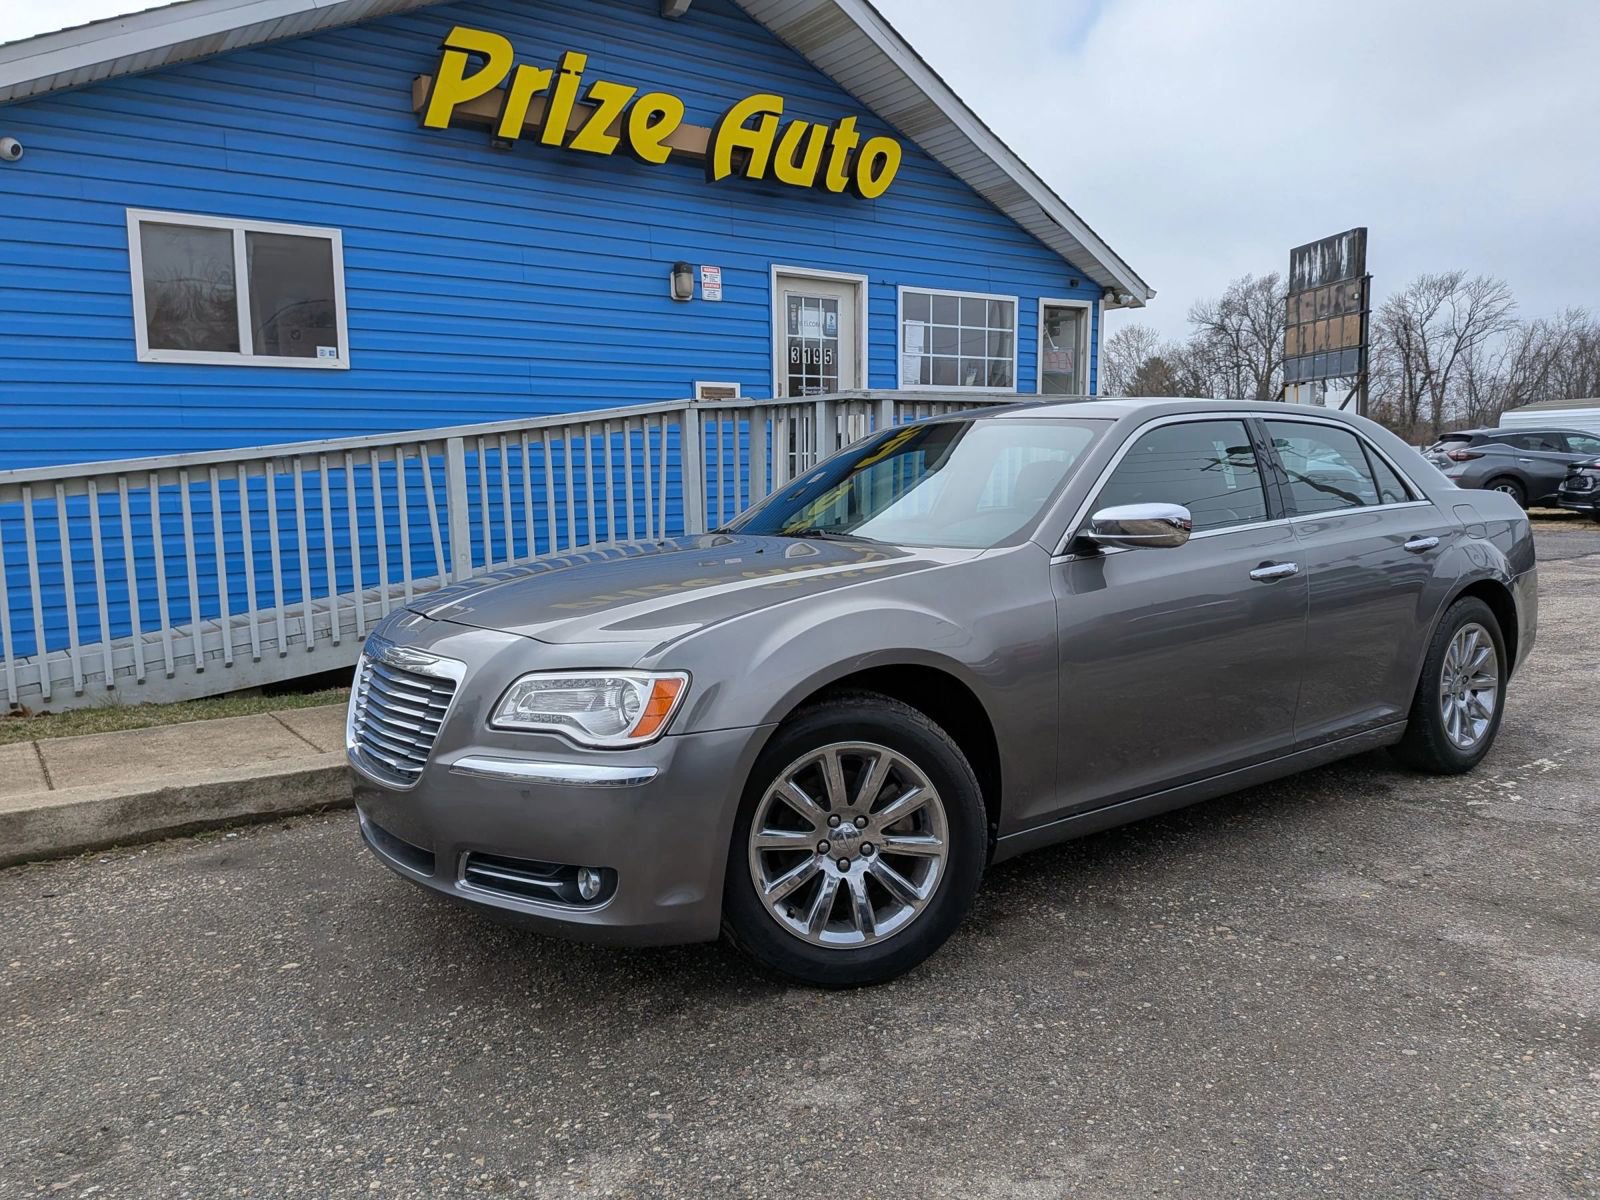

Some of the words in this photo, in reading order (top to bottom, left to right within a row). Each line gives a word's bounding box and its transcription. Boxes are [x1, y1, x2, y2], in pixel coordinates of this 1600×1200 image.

[424, 25, 686, 165] Prize
[711, 93, 902, 199] Auto
[792, 347, 831, 364] 3195
